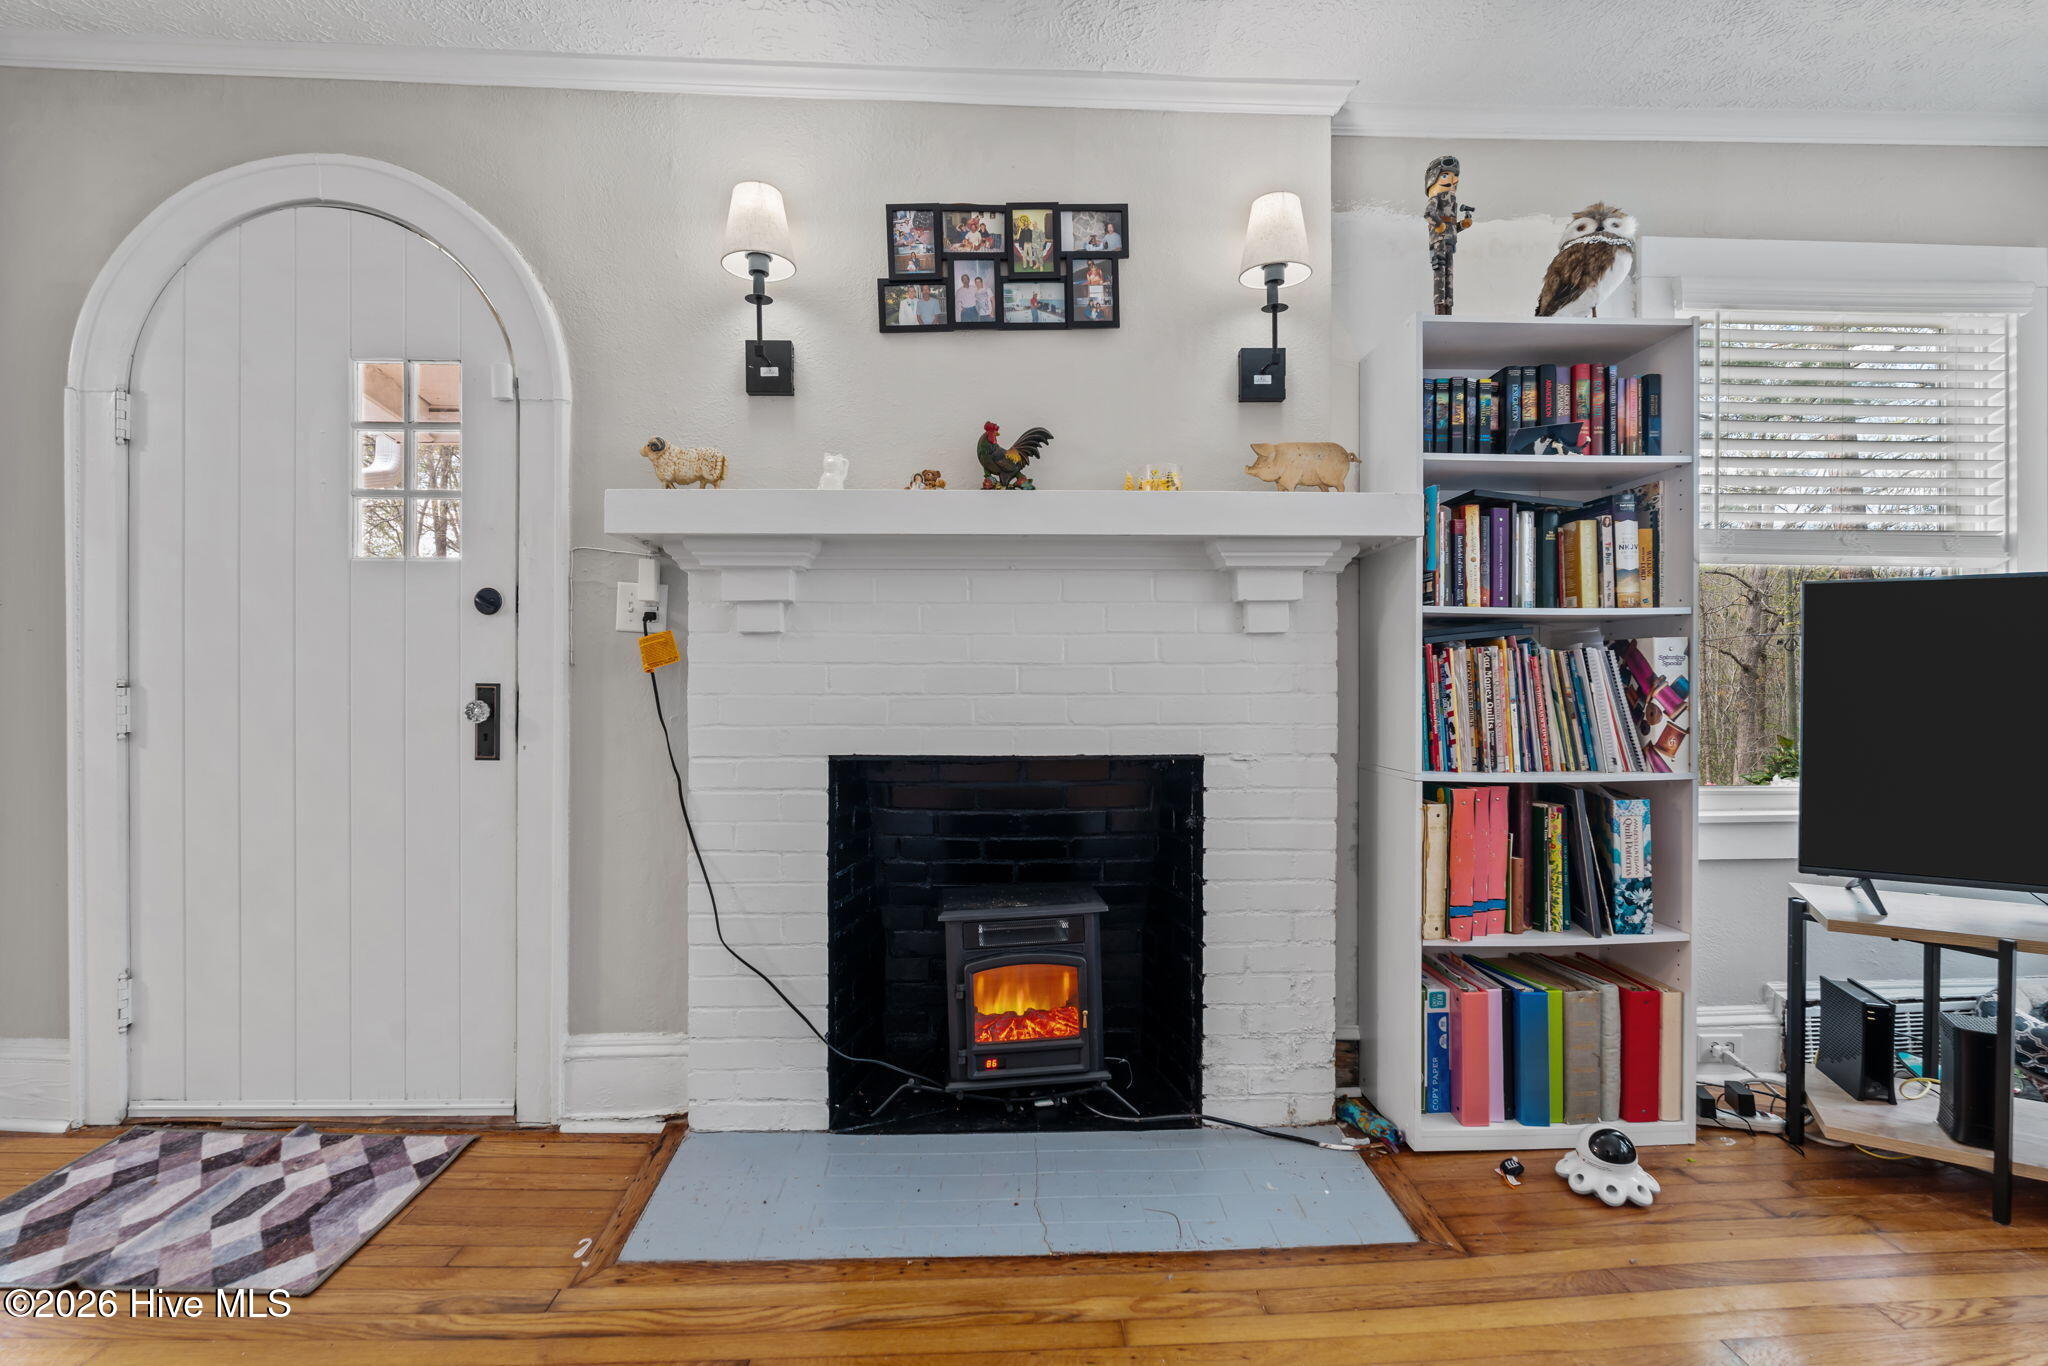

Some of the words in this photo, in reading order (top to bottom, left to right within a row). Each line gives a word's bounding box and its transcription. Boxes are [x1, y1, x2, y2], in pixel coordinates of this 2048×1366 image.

[1484, 670, 1493, 699] Money
[1486, 701, 1495, 729] Quilts
[1623, 818, 1633, 840] Quilt
[1624, 841, 1633, 876] Patterns
